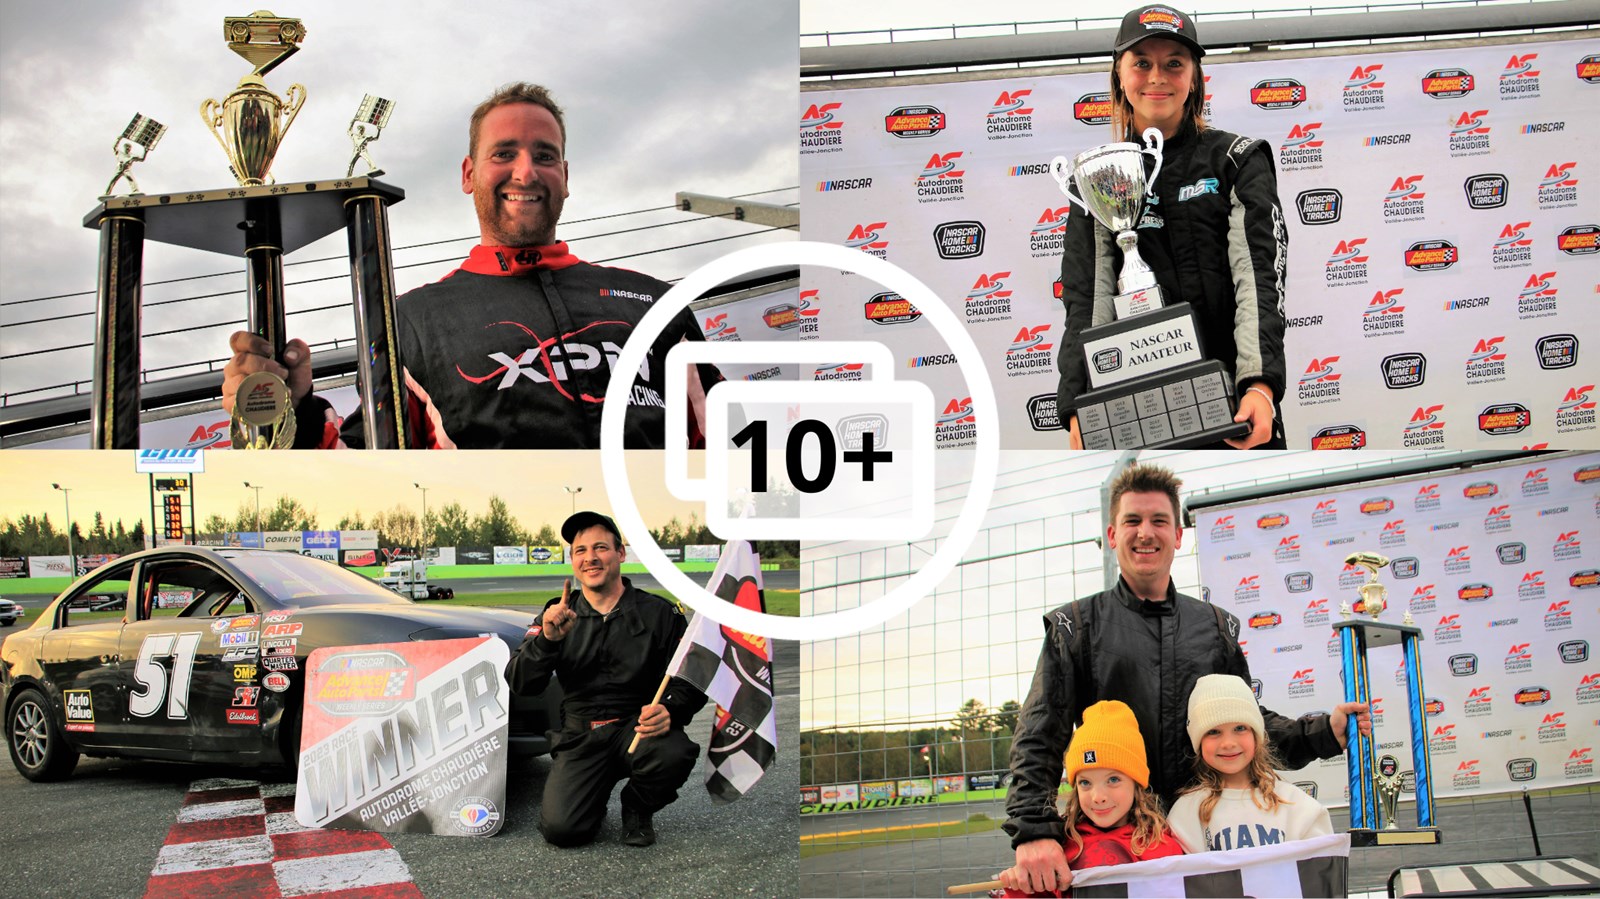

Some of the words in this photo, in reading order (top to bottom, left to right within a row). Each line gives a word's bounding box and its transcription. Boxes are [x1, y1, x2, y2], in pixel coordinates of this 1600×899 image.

[1500, 77, 1539, 87] Autodrome
[1343, 88, 1383, 98] Autodrome
[1500, 84, 1539, 94] CHAUDIERE
[1344, 95, 1384, 105] CHAUDIERE
[987, 115, 1031, 124] Autodrome
[987, 122, 1032, 133] CHAUDIERE
[1530, 122, 1565, 133] NASCAR
[1374, 134, 1411, 146] NASCAR
[1450, 134, 1489, 143] Autodrome
[1450, 140, 1490, 151] CHAUDIERE
[1280, 148, 1322, 157] Autodrome
[1280, 154, 1323, 165] CHAUDIERE
[830, 178, 872, 190] NASCAR
[917, 178, 963, 187] Autodrome
[1475, 179, 1503, 188] NASCAR
[918, 185, 963, 196] CHAUDIERE
[1472, 188, 1493, 197] HOME
[1538, 186, 1576, 196] Autodrome
[1306, 196, 1336, 204] NASCAR
[1474, 195, 1502, 205] TRACKS
[1539, 193, 1577, 203] CHAUDIERE
[1384, 200, 1424, 209] Autodrome
[1306, 211, 1335, 220] TRACKS
[1384, 207, 1424, 217] CHAUDIERE
[946, 227, 978, 237] NASCAR
[942, 236, 966, 244] HOME
[945, 244, 976, 254] TRACKS
[1493, 246, 1531, 256] Autodrome
[1493, 252, 1531, 263] CHAUDIERE
[1326, 263, 1367, 273] Autodrome
[1326, 270, 1367, 280] CHAUDIERE
[613, 289, 652, 302] NASCAR
[1518, 296, 1556, 305] Autodrome
[965, 297, 1010, 308] Autodrome
[1454, 297, 1490, 309] NASCAR
[1518, 302, 1556, 313] CHAUDIERE
[966, 304, 1011, 316] CHAUDIERE
[1285, 316, 1323, 328] NASCAR
[1363, 313, 1404, 323] Autodrome
[1363, 320, 1404, 331] CHAUDIERE
[1130, 328, 1184, 351] NASCAR
[1544, 340, 1573, 350] NASCAR
[1006, 350, 1051, 361] Autodrome
[1128, 341, 1193, 367] AMATEUR
[1542, 348, 1562, 357] HOME
[921, 354, 958, 367] NASCA
[1007, 357, 1051, 370] CHAUDIERE
[1391, 359, 1420, 368] NASCAR
[1545, 356, 1572, 364] TRACKS
[1466, 361, 1505, 371] Autodrome
[752, 367, 781, 382] NASCAR
[814, 371, 862, 381] Autodrome
[1388, 368, 1410, 376] HOME
[1466, 368, 1506, 378] CHAUDIERE
[1392, 374, 1419, 384] TRACKS
[1298, 381, 1340, 392] Autodrome
[627, 384, 666, 409] ACING
[1299, 388, 1340, 400] CHAUDIERE
[1556, 409, 1595, 420] Autodrome
[1557, 416, 1596, 427] CHAUDIERE
[1404, 430, 1444, 440] Autodrome
[1404, 436, 1444, 448] CHAUDIERE
[263, 615, 288, 623] MSD
[262, 624, 302, 635] ARP
[222, 633, 246, 643] Mobil
[248, 633, 257, 642] 1
[263, 640, 290, 648] LINCOLN
[224, 647, 259, 656] PFC
[263, 657, 294, 666] QUARTER
[352, 657, 385, 667] NASCAR
[129, 632, 202, 720] 51
[234, 667, 257, 678] OMP
[268, 677, 286, 685] BELL
[327, 674, 383, 687] Advance
[318, 686, 347, 698] Auto
[348, 684, 383, 697] Parts
[68, 693, 89, 706] Auto
[336, 702, 362, 710] WEEKLY
[67, 706, 91, 719] Value
[229, 712, 257, 720] Edelbrock
[304, 660, 506, 823] WINNER
[304, 745, 330, 767] 2023
[332, 727, 358, 753] RACE
[359, 772, 431, 822] AUTODROME
[382, 762, 489, 827] VALLÉE-JONCTION
[800, 794, 939, 815] CHAUDIERE
